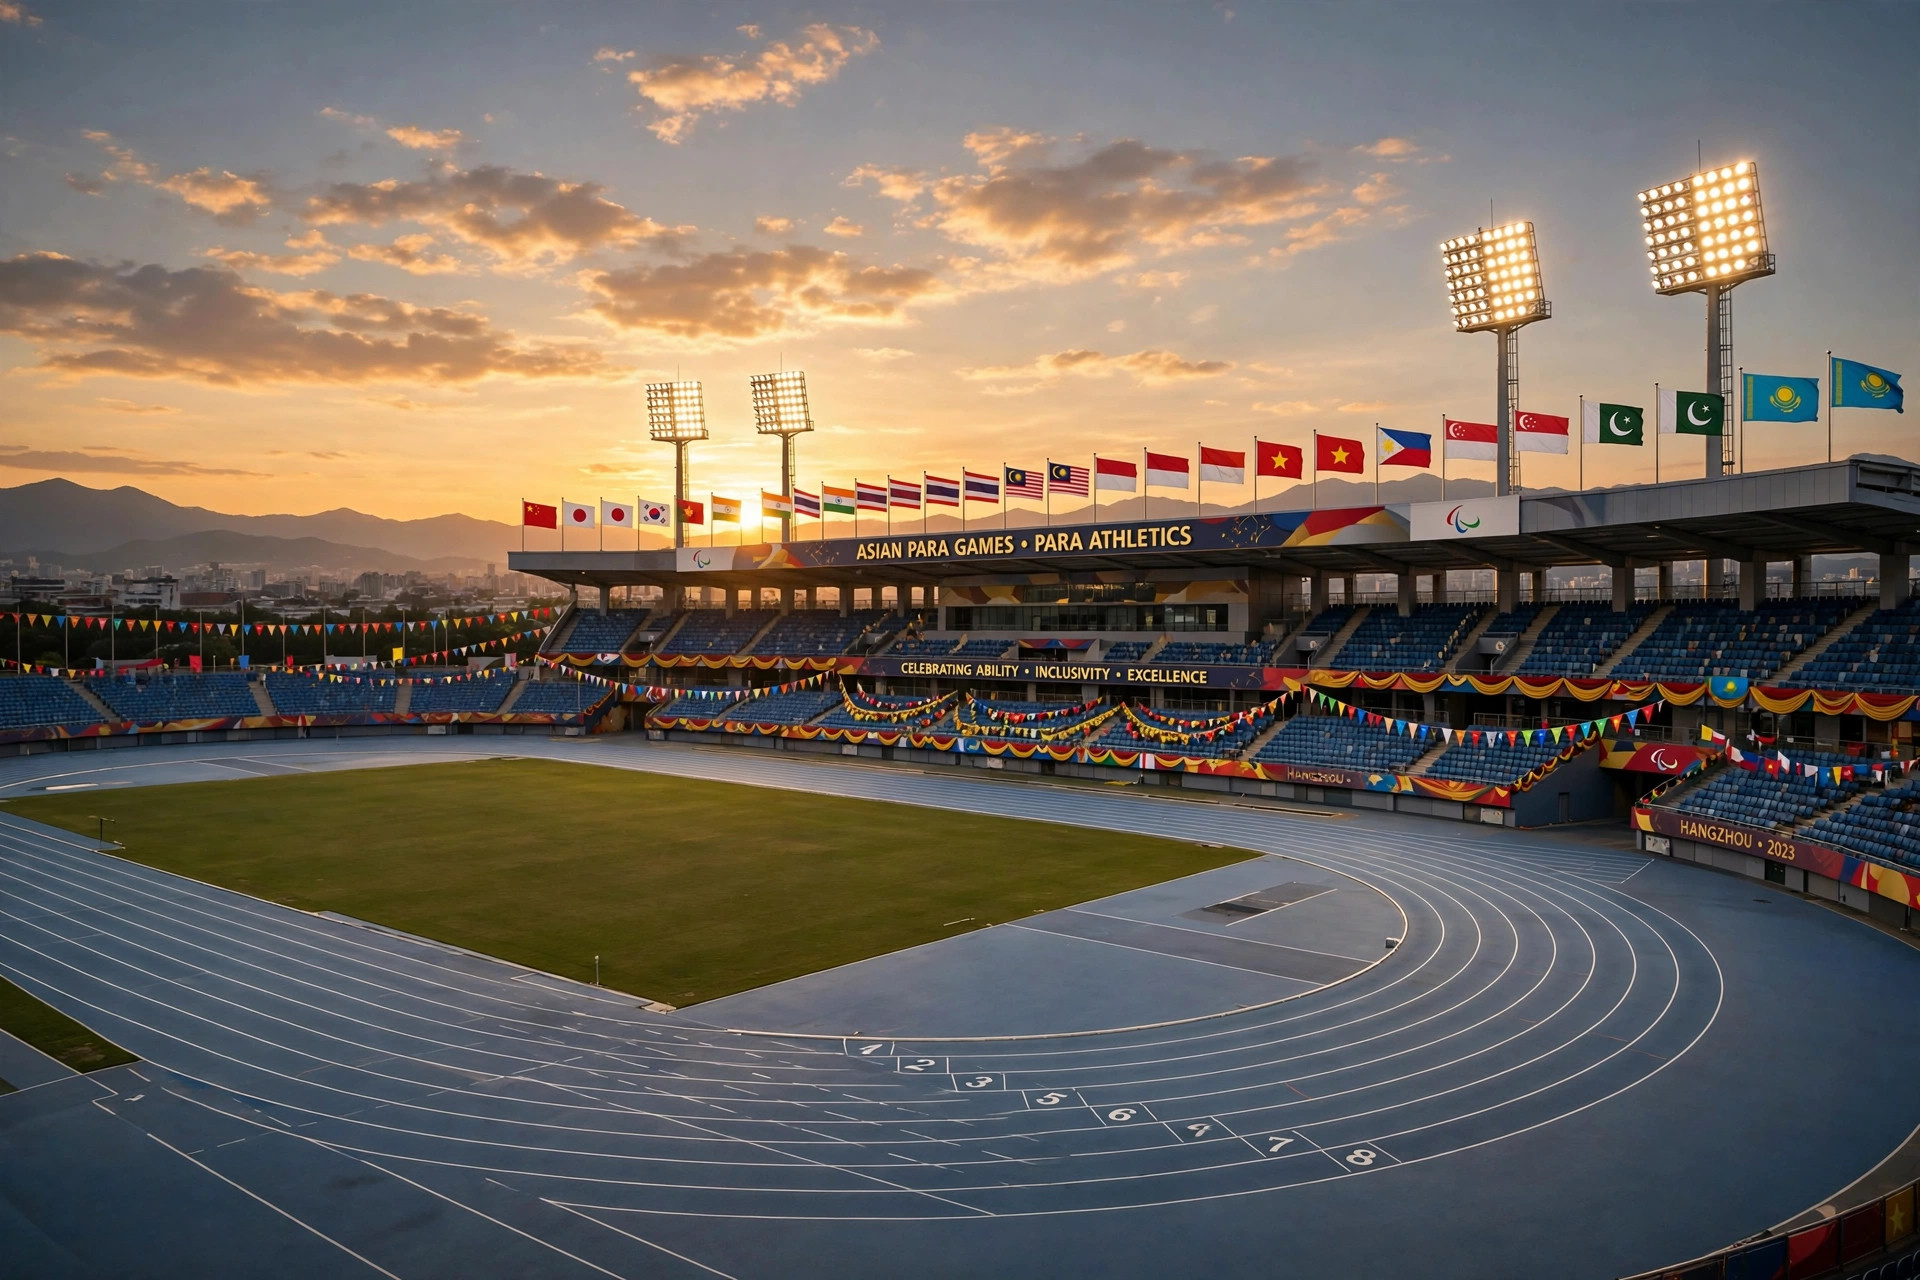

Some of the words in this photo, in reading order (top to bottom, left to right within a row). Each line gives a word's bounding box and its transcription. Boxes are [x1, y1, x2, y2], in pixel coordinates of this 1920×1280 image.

[856, 542, 902, 560] ASIAN
[908, 539, 950, 558] PARA
[954, 535, 1015, 556] GAMES
[1035, 532, 1083, 552] PARA
[1089, 525, 1192, 550] ATHLETICS
[901, 662, 972, 676] CELEBRATING
[976, 664, 1019, 678] ABILITY
[1035, 665, 1111, 681] INCLUSIVITY
[1127, 668, 1207, 684] EXCELLENCE
[1680, 819, 1752, 849] HANGZHOU
[1767, 839, 1795, 860] 2023
[904, 1058, 936, 1072] 2
[965, 1076, 993, 1088] 3
[1036, 1092, 1068, 1105] 5
[1108, 1108, 1137, 1121] 6
[1269, 1136, 1294, 1152] 7
[1345, 1149, 1376, 1166] 8
